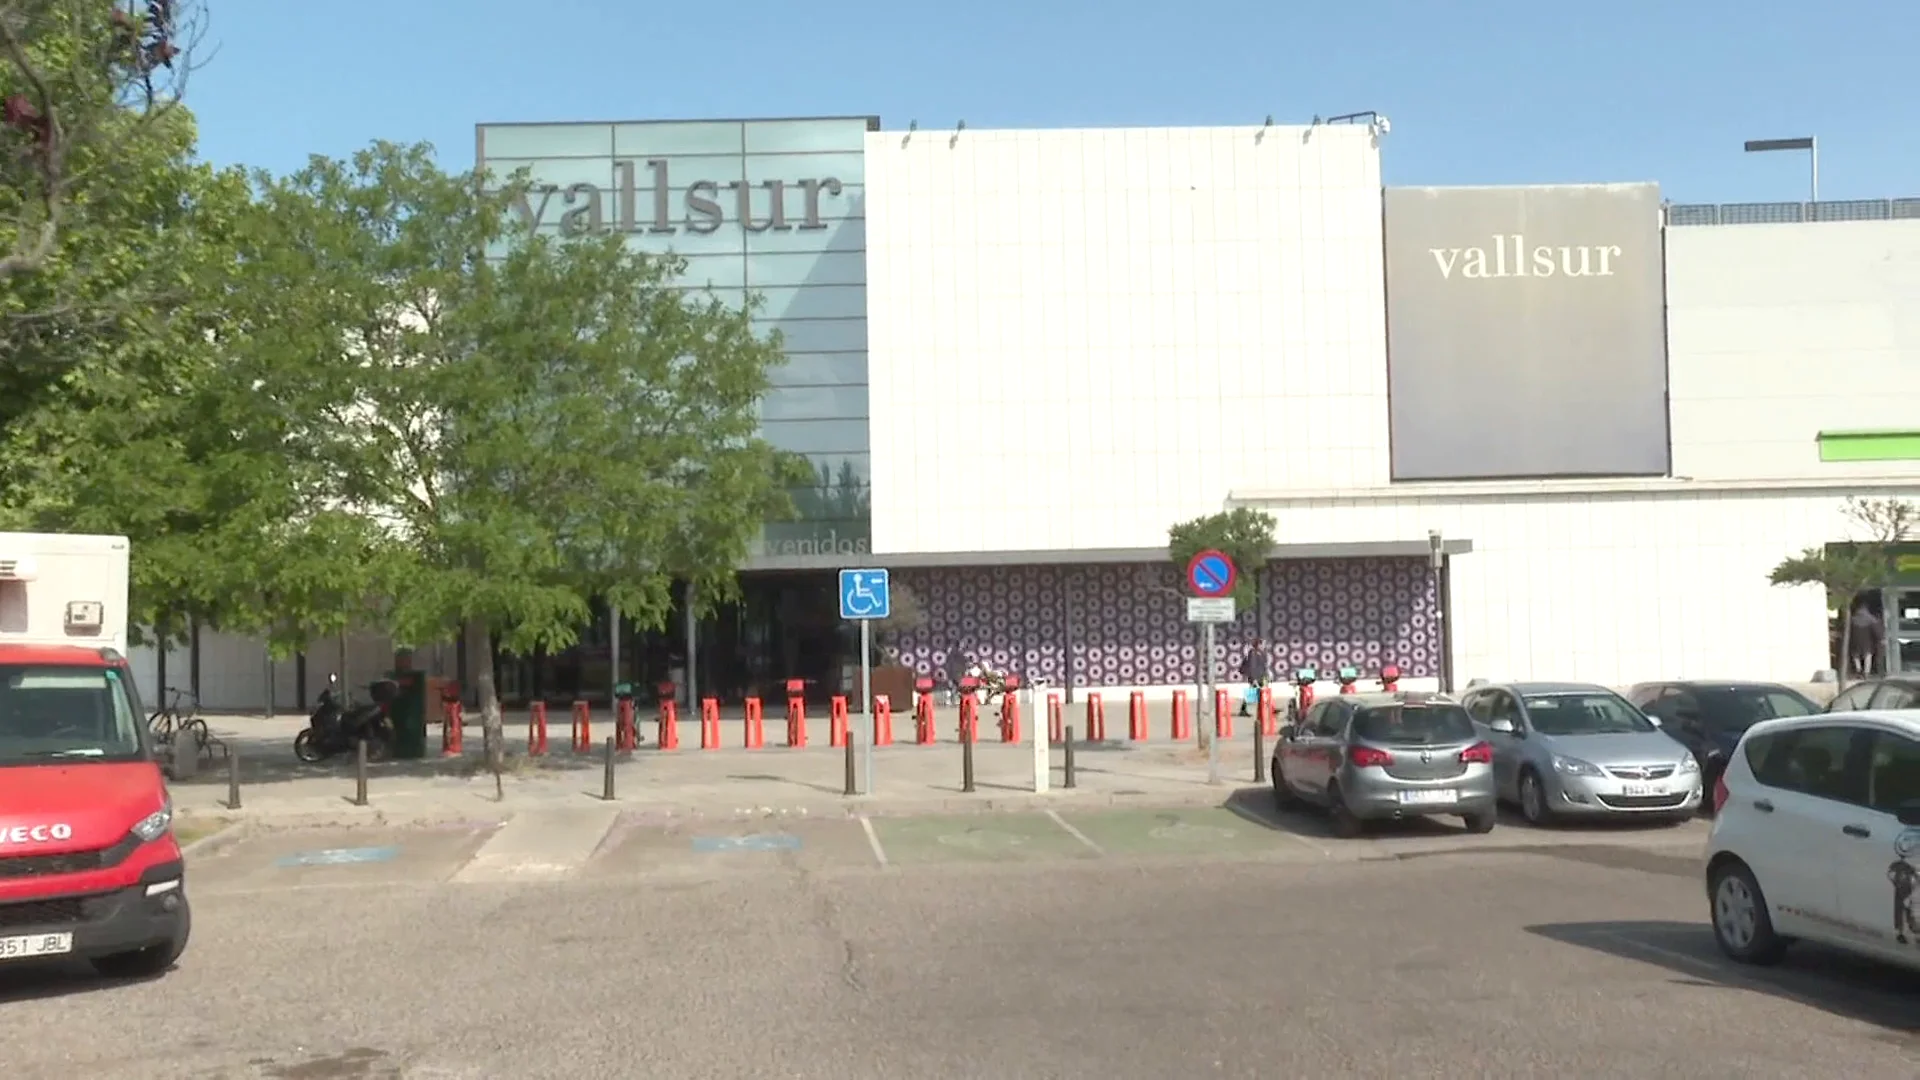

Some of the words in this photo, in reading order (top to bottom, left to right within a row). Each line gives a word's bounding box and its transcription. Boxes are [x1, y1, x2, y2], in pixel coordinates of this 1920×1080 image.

[504, 159, 842, 239] vallsur
[1429, 233, 1622, 280] vallsur
[36, 935, 67, 952] JBL
